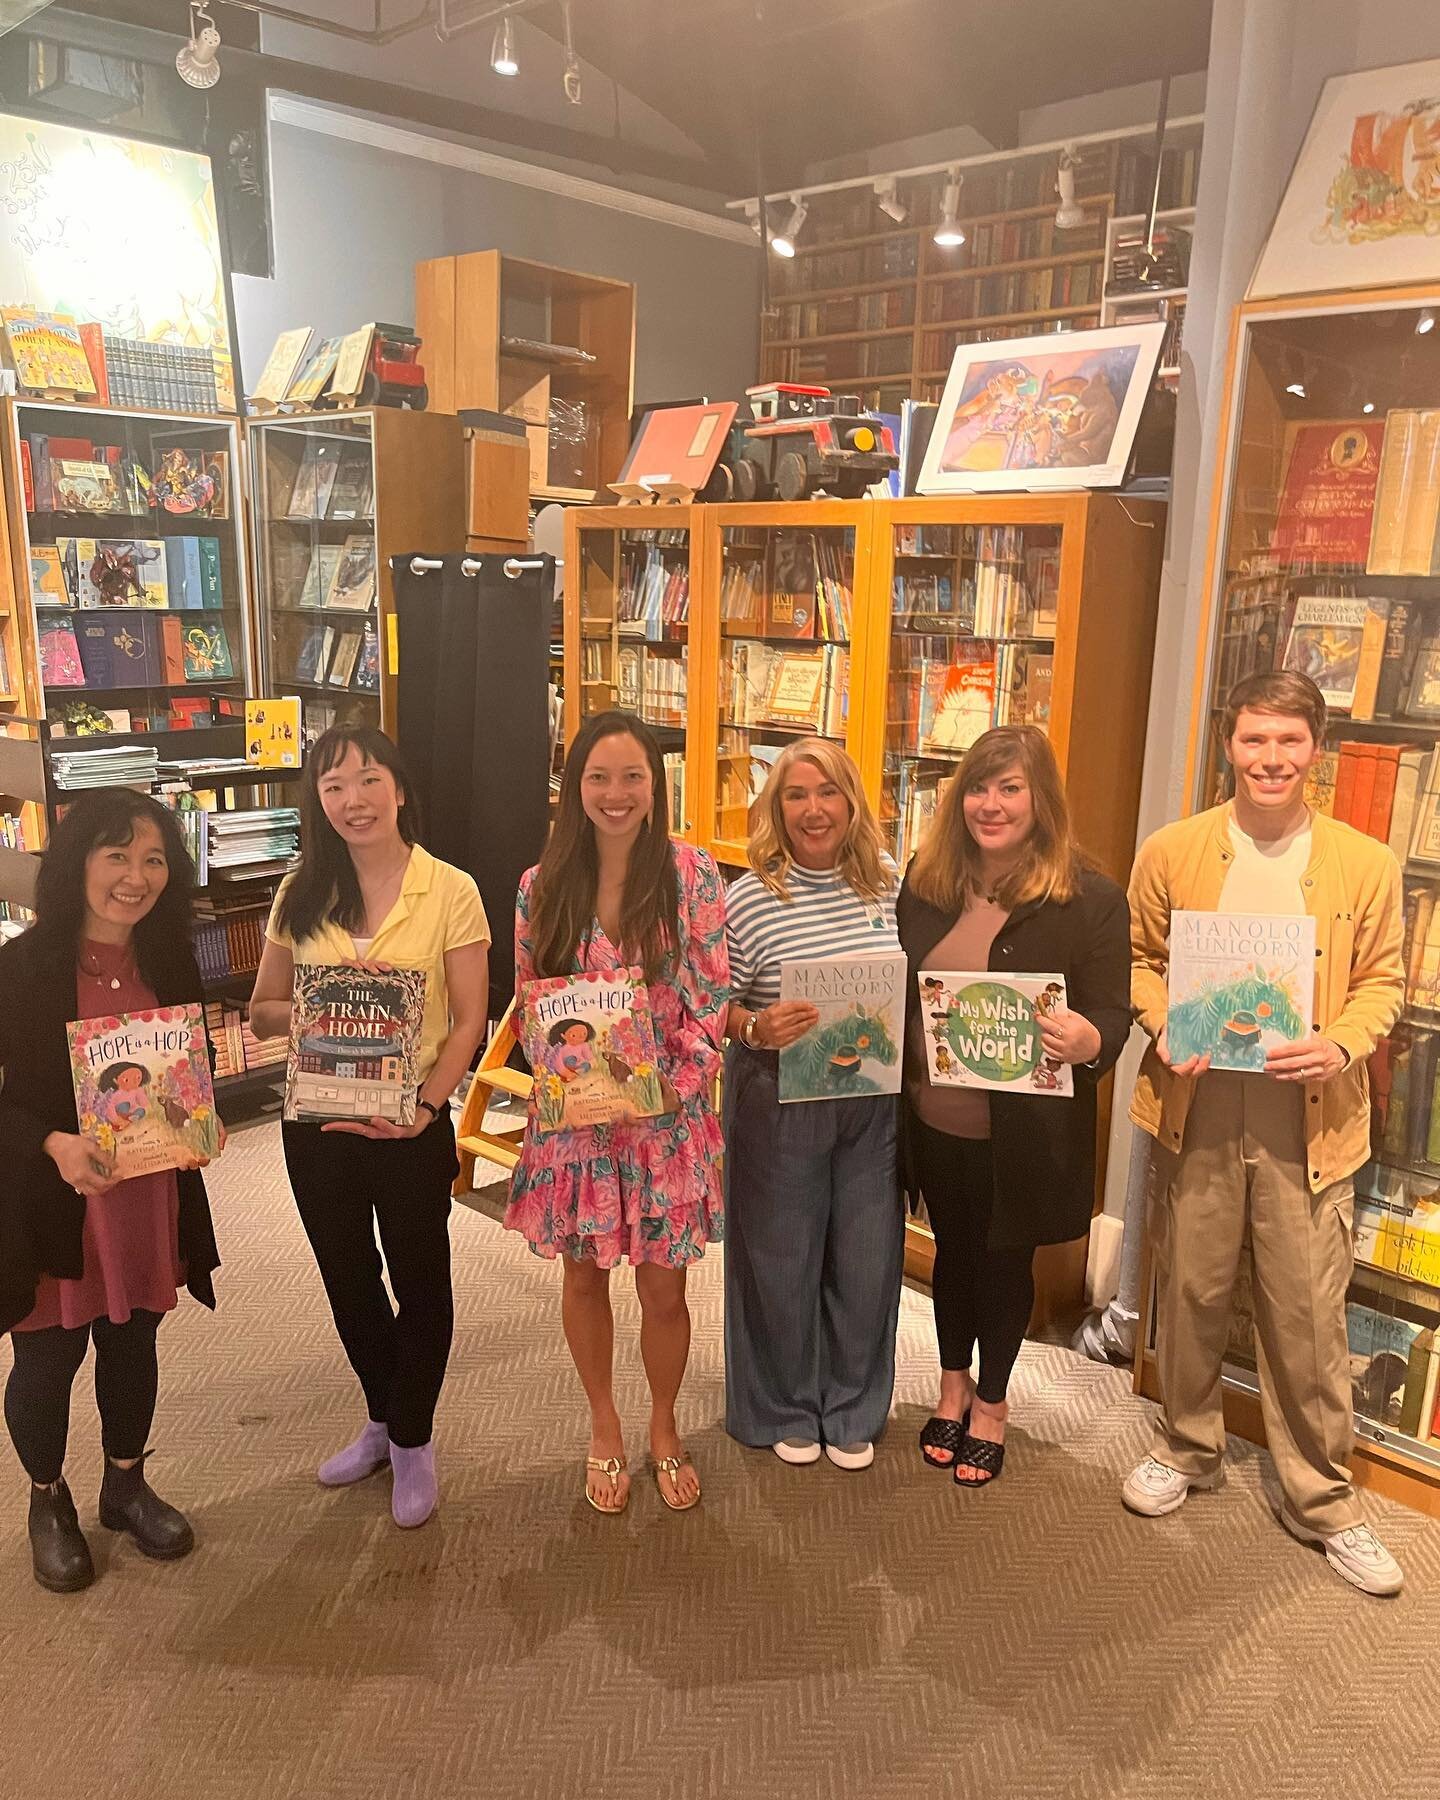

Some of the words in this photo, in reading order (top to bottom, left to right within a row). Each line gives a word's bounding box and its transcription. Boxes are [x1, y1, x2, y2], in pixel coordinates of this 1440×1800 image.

[1184, 919, 1301, 939] MANOLO
[1196, 937, 1301, 957] UNICORN
[794, 963, 895, 984] MANOLO
[347, 989, 375, 1001] THE
[804, 980, 895, 997] UNICORN
[327, 1002, 391, 1021] TRAIN
[539, 993, 583, 1022] HOPE
[581, 997, 588, 1007] is
[599, 991, 632, 1010] HOP
[959, 1000, 980, 1019] My
[980, 996, 1030, 1021] Wish
[328, 1020, 386, 1039] HOME
[969, 1020, 992, 1035] for
[995, 1021, 1018, 1037] the
[88, 1034, 136, 1066] HOPE
[134, 1037, 142, 1048] is
[154, 1030, 190, 1051] HOP
[958, 1034, 1034, 1065] World
